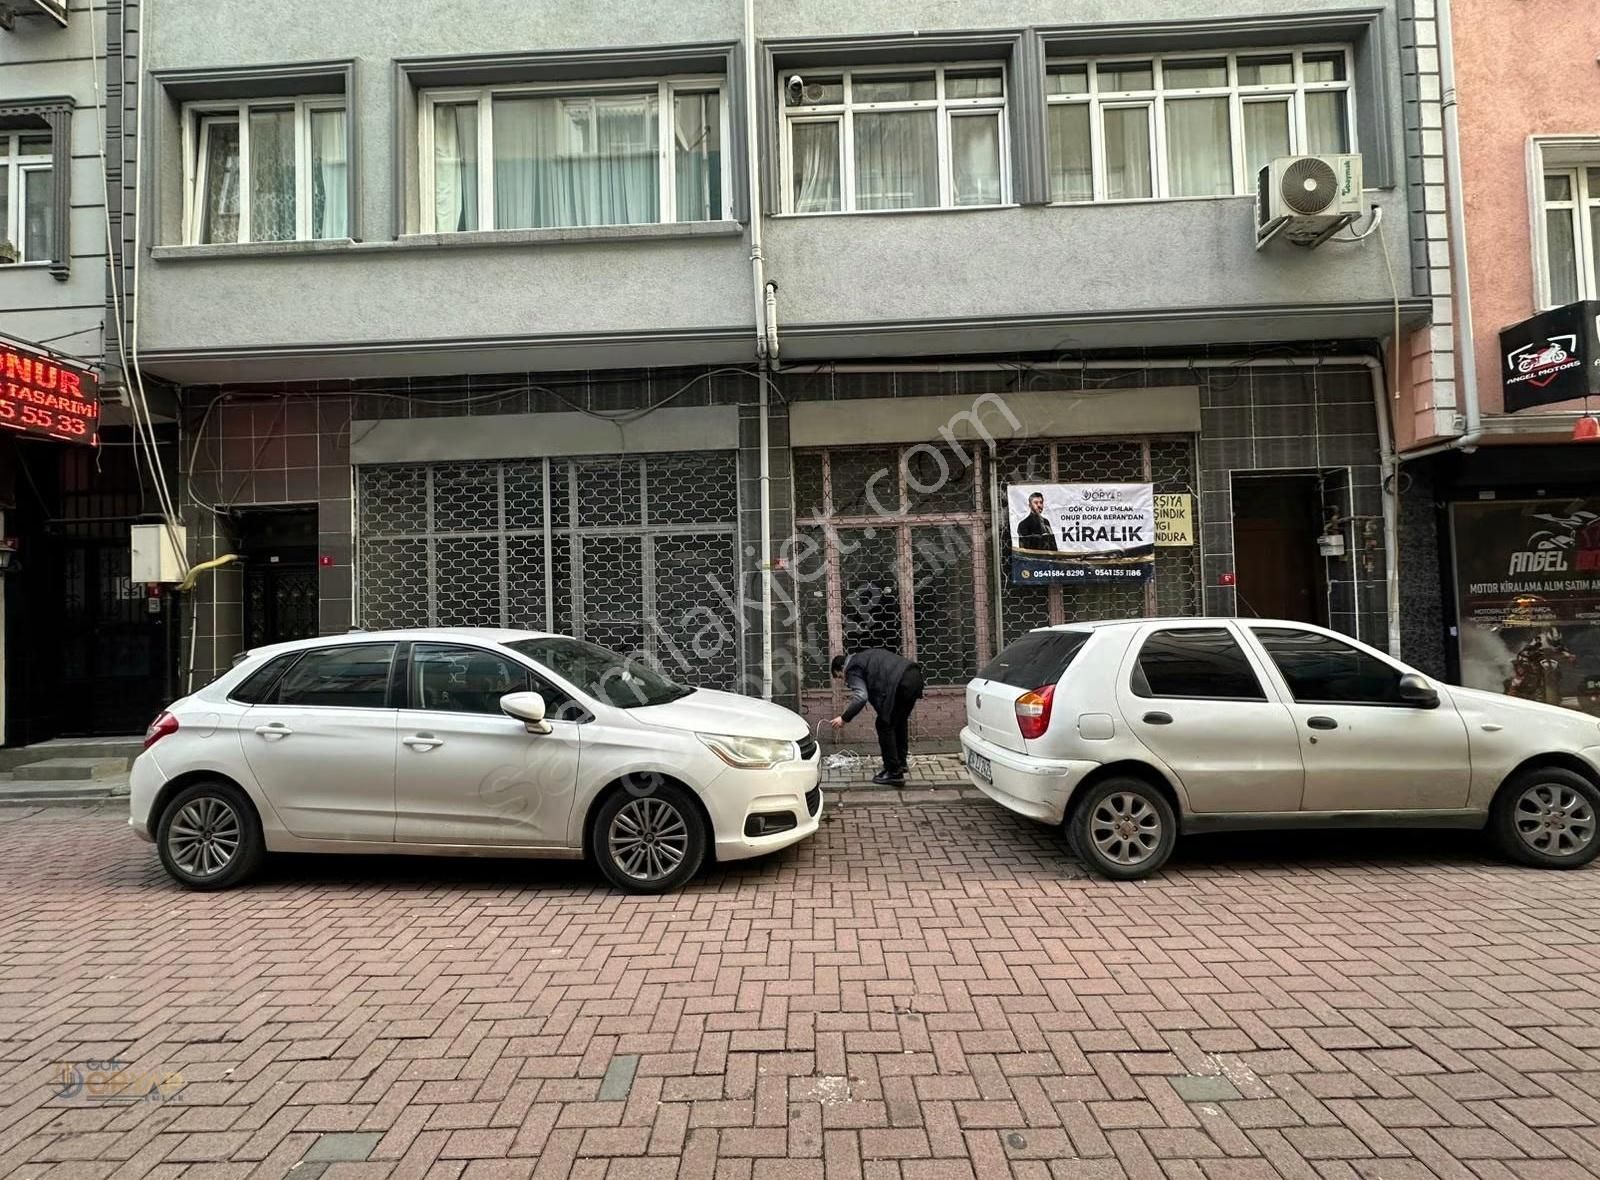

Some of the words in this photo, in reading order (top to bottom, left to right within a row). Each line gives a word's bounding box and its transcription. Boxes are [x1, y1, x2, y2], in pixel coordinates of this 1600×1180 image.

[0, 353, 84, 398] NUR
[1507, 373, 1537, 384] ANGEL
[1538, 361, 1581, 377] MOTORS
[21, 405, 52, 427] 55
[57, 415, 87, 435] 33
[1061, 521, 1144, 542] KİRALIK
[1509, 550, 1568, 576] ANGEL
[1470, 583, 1499, 594] MOTOR
[1500, 580, 1542, 592] KİRALAMA
[1544, 581, 1564, 591] ALIM
[1565, 580, 1590, 591] SATIM
